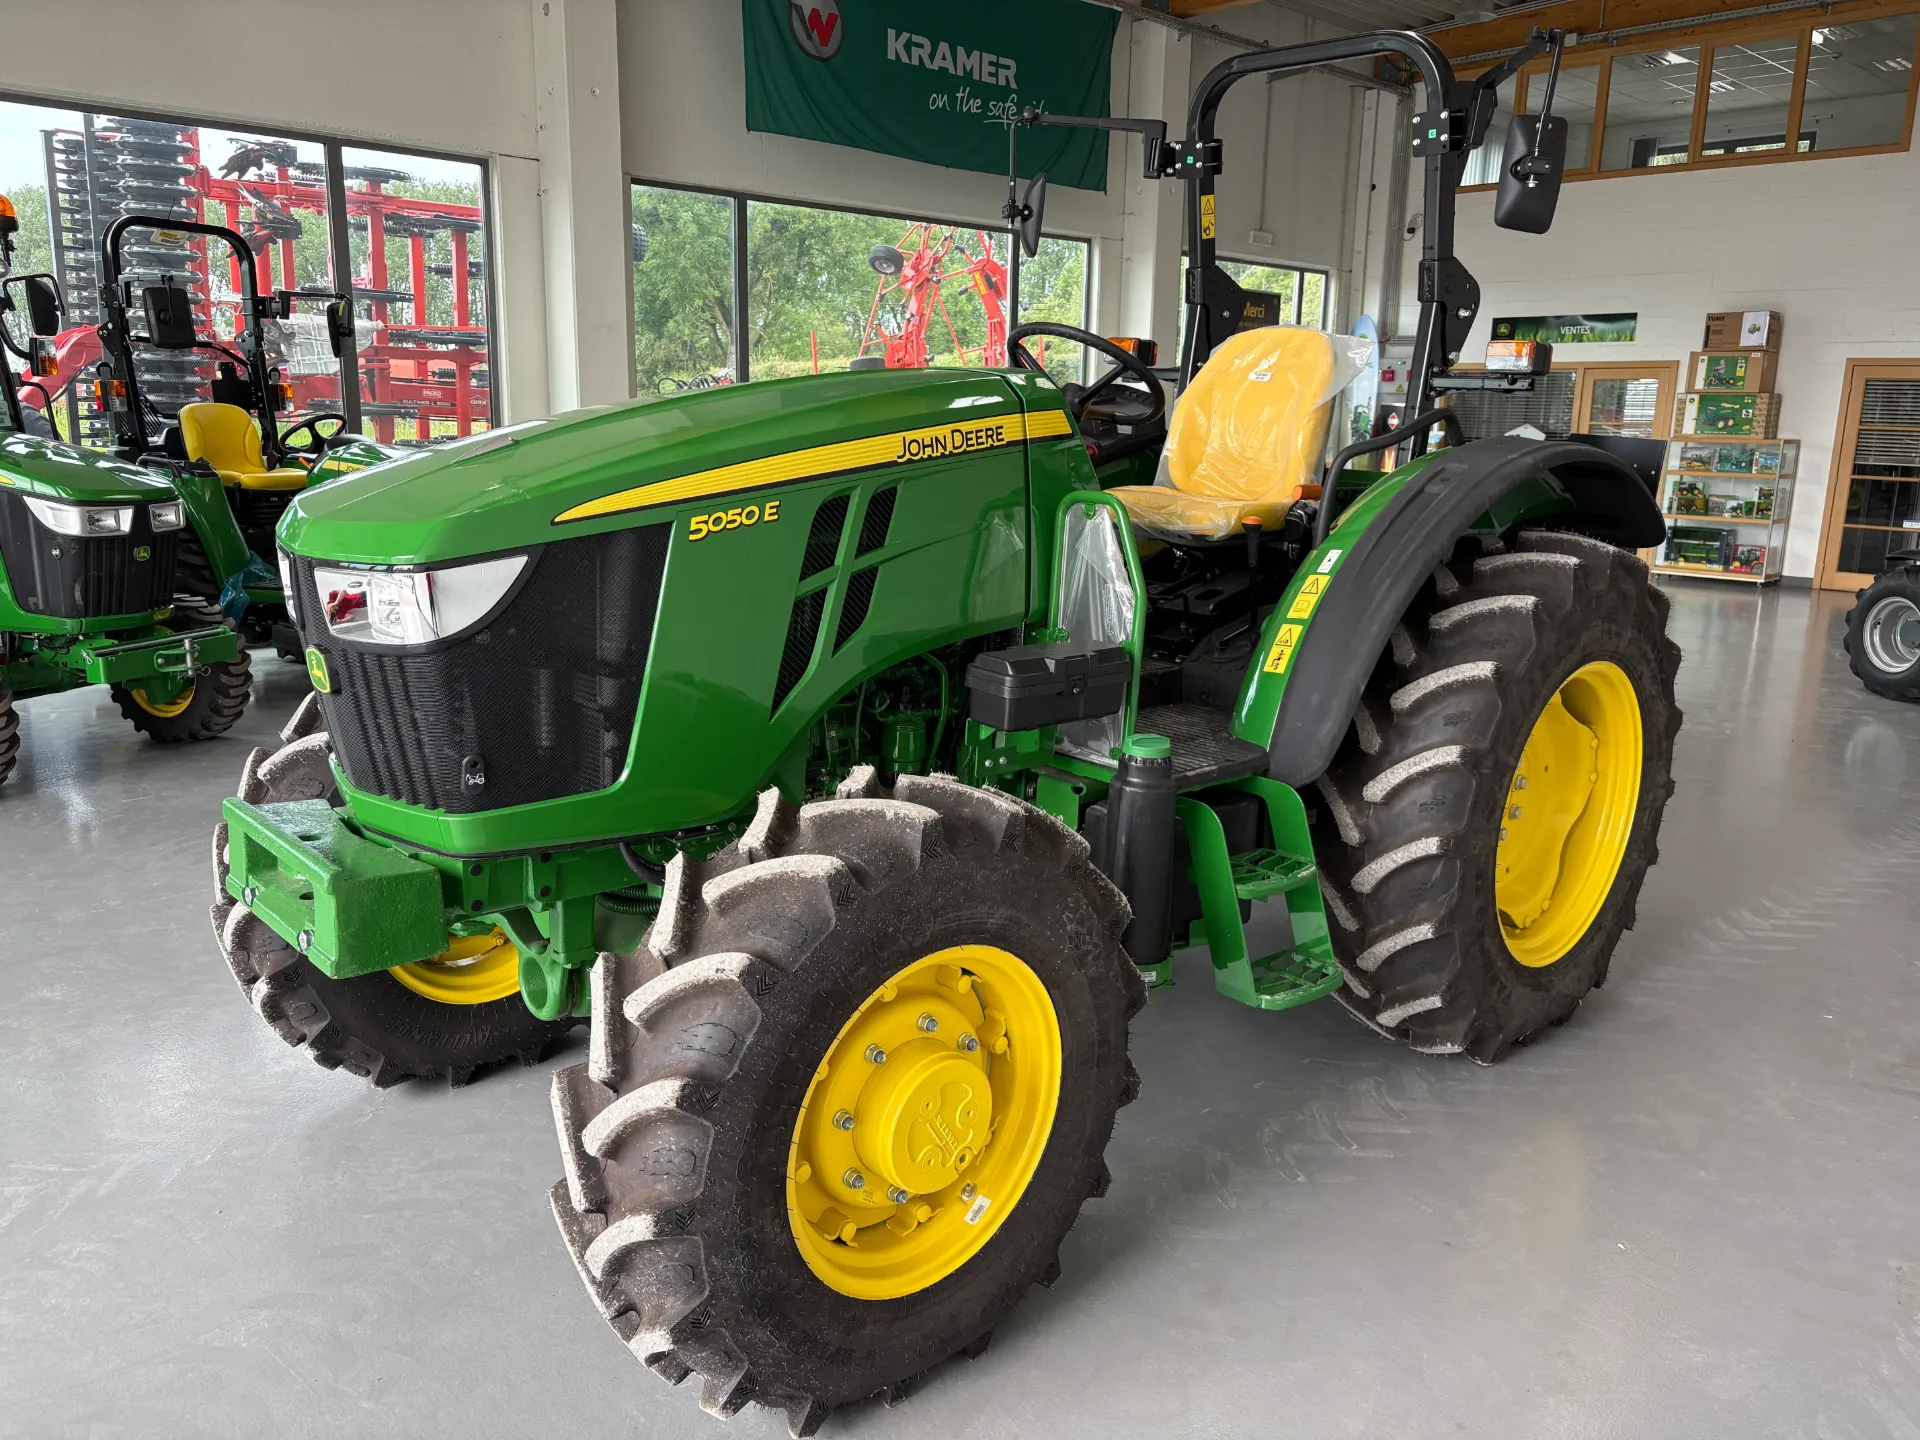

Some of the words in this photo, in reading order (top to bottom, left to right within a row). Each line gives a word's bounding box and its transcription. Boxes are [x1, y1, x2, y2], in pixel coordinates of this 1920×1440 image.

[887, 28, 1018, 89] KRAMER
[929, 93, 951, 111] on
[956, 86, 982, 113] the
[987, 94, 1018, 130] safe
[1560, 325, 1591, 335] VENTES
[896, 436, 949, 460] JOHN
[951, 425, 1005, 451] DEERE
[688, 505, 761, 541] 5050
[764, 500, 781, 522] E
[940, 1122, 959, 1152] LEVEL
